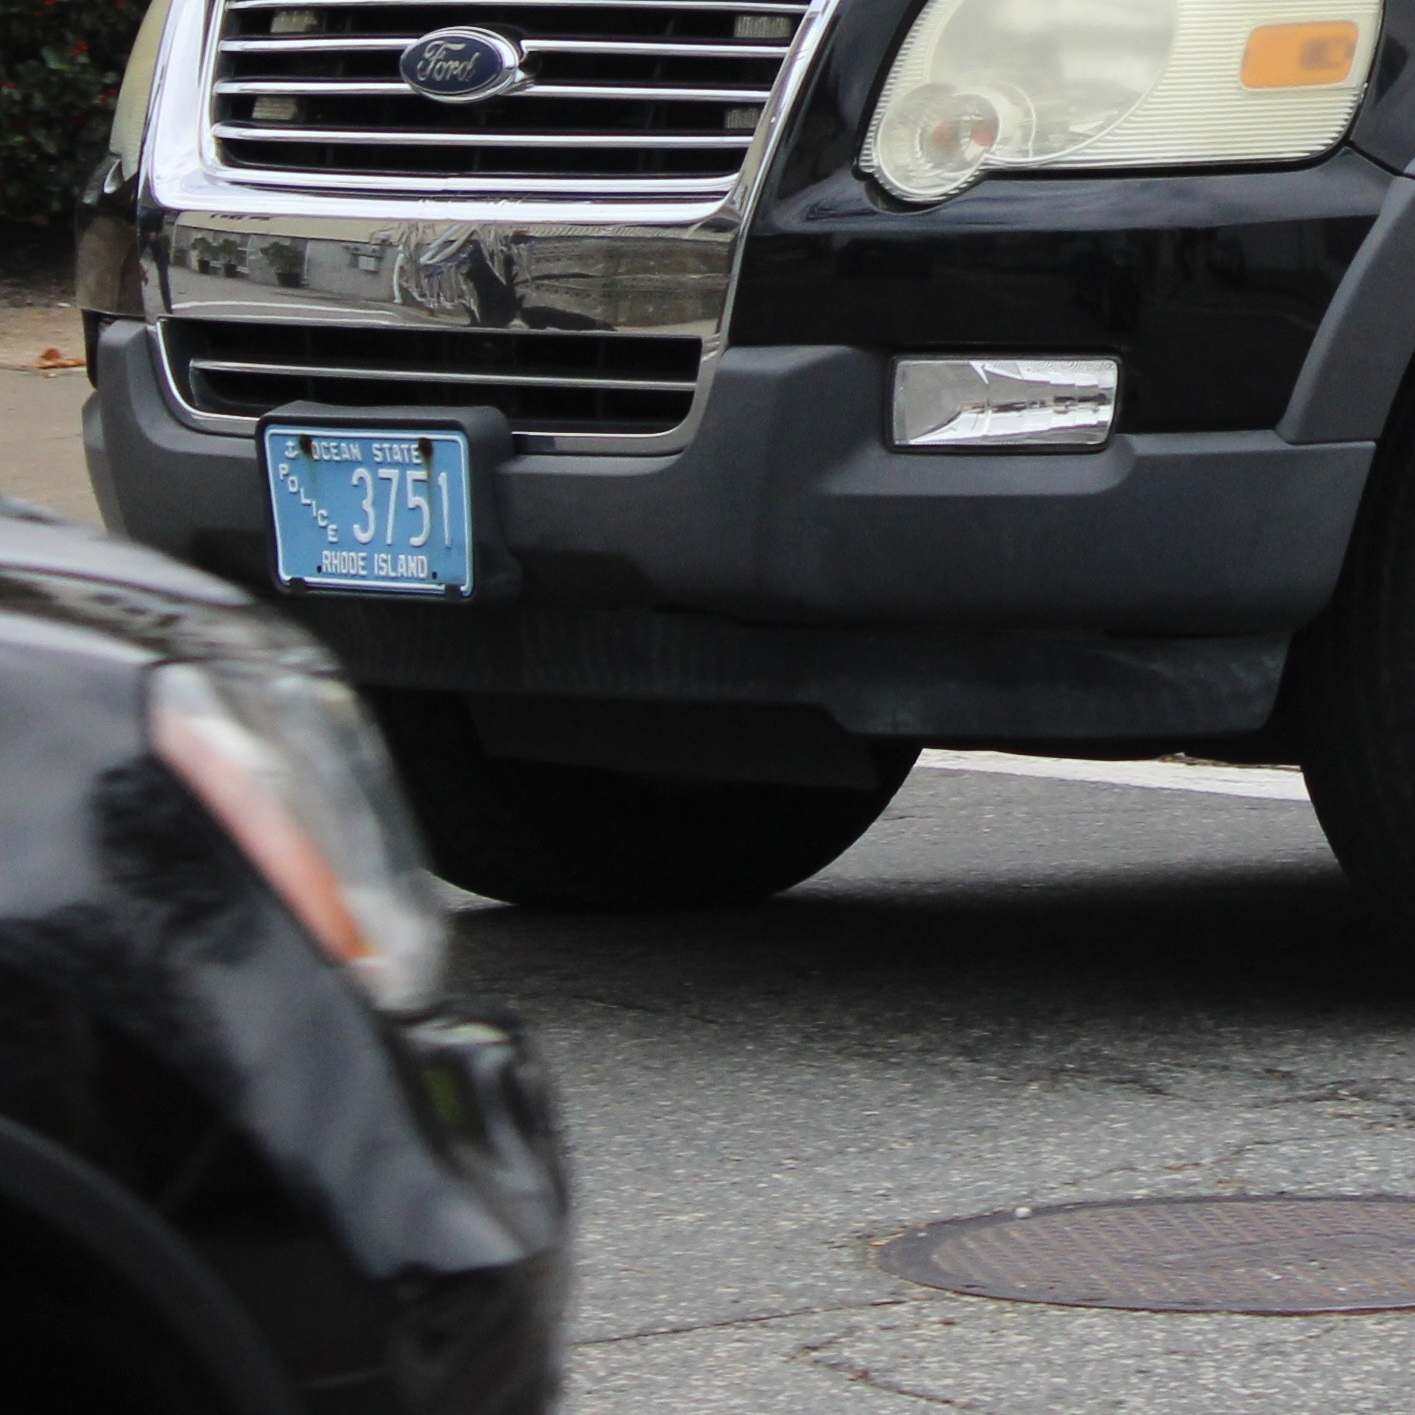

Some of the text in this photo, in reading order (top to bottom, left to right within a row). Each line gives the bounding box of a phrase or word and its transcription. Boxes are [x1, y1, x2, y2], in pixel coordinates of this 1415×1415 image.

[417, 40, 481, 82] Ford
[311, 441, 422, 463] OCEAN STATE
[278, 463, 338, 544] POLICE
[352, 468, 452, 549] 3751
[322, 550, 428, 578] RHODE ISLAND
